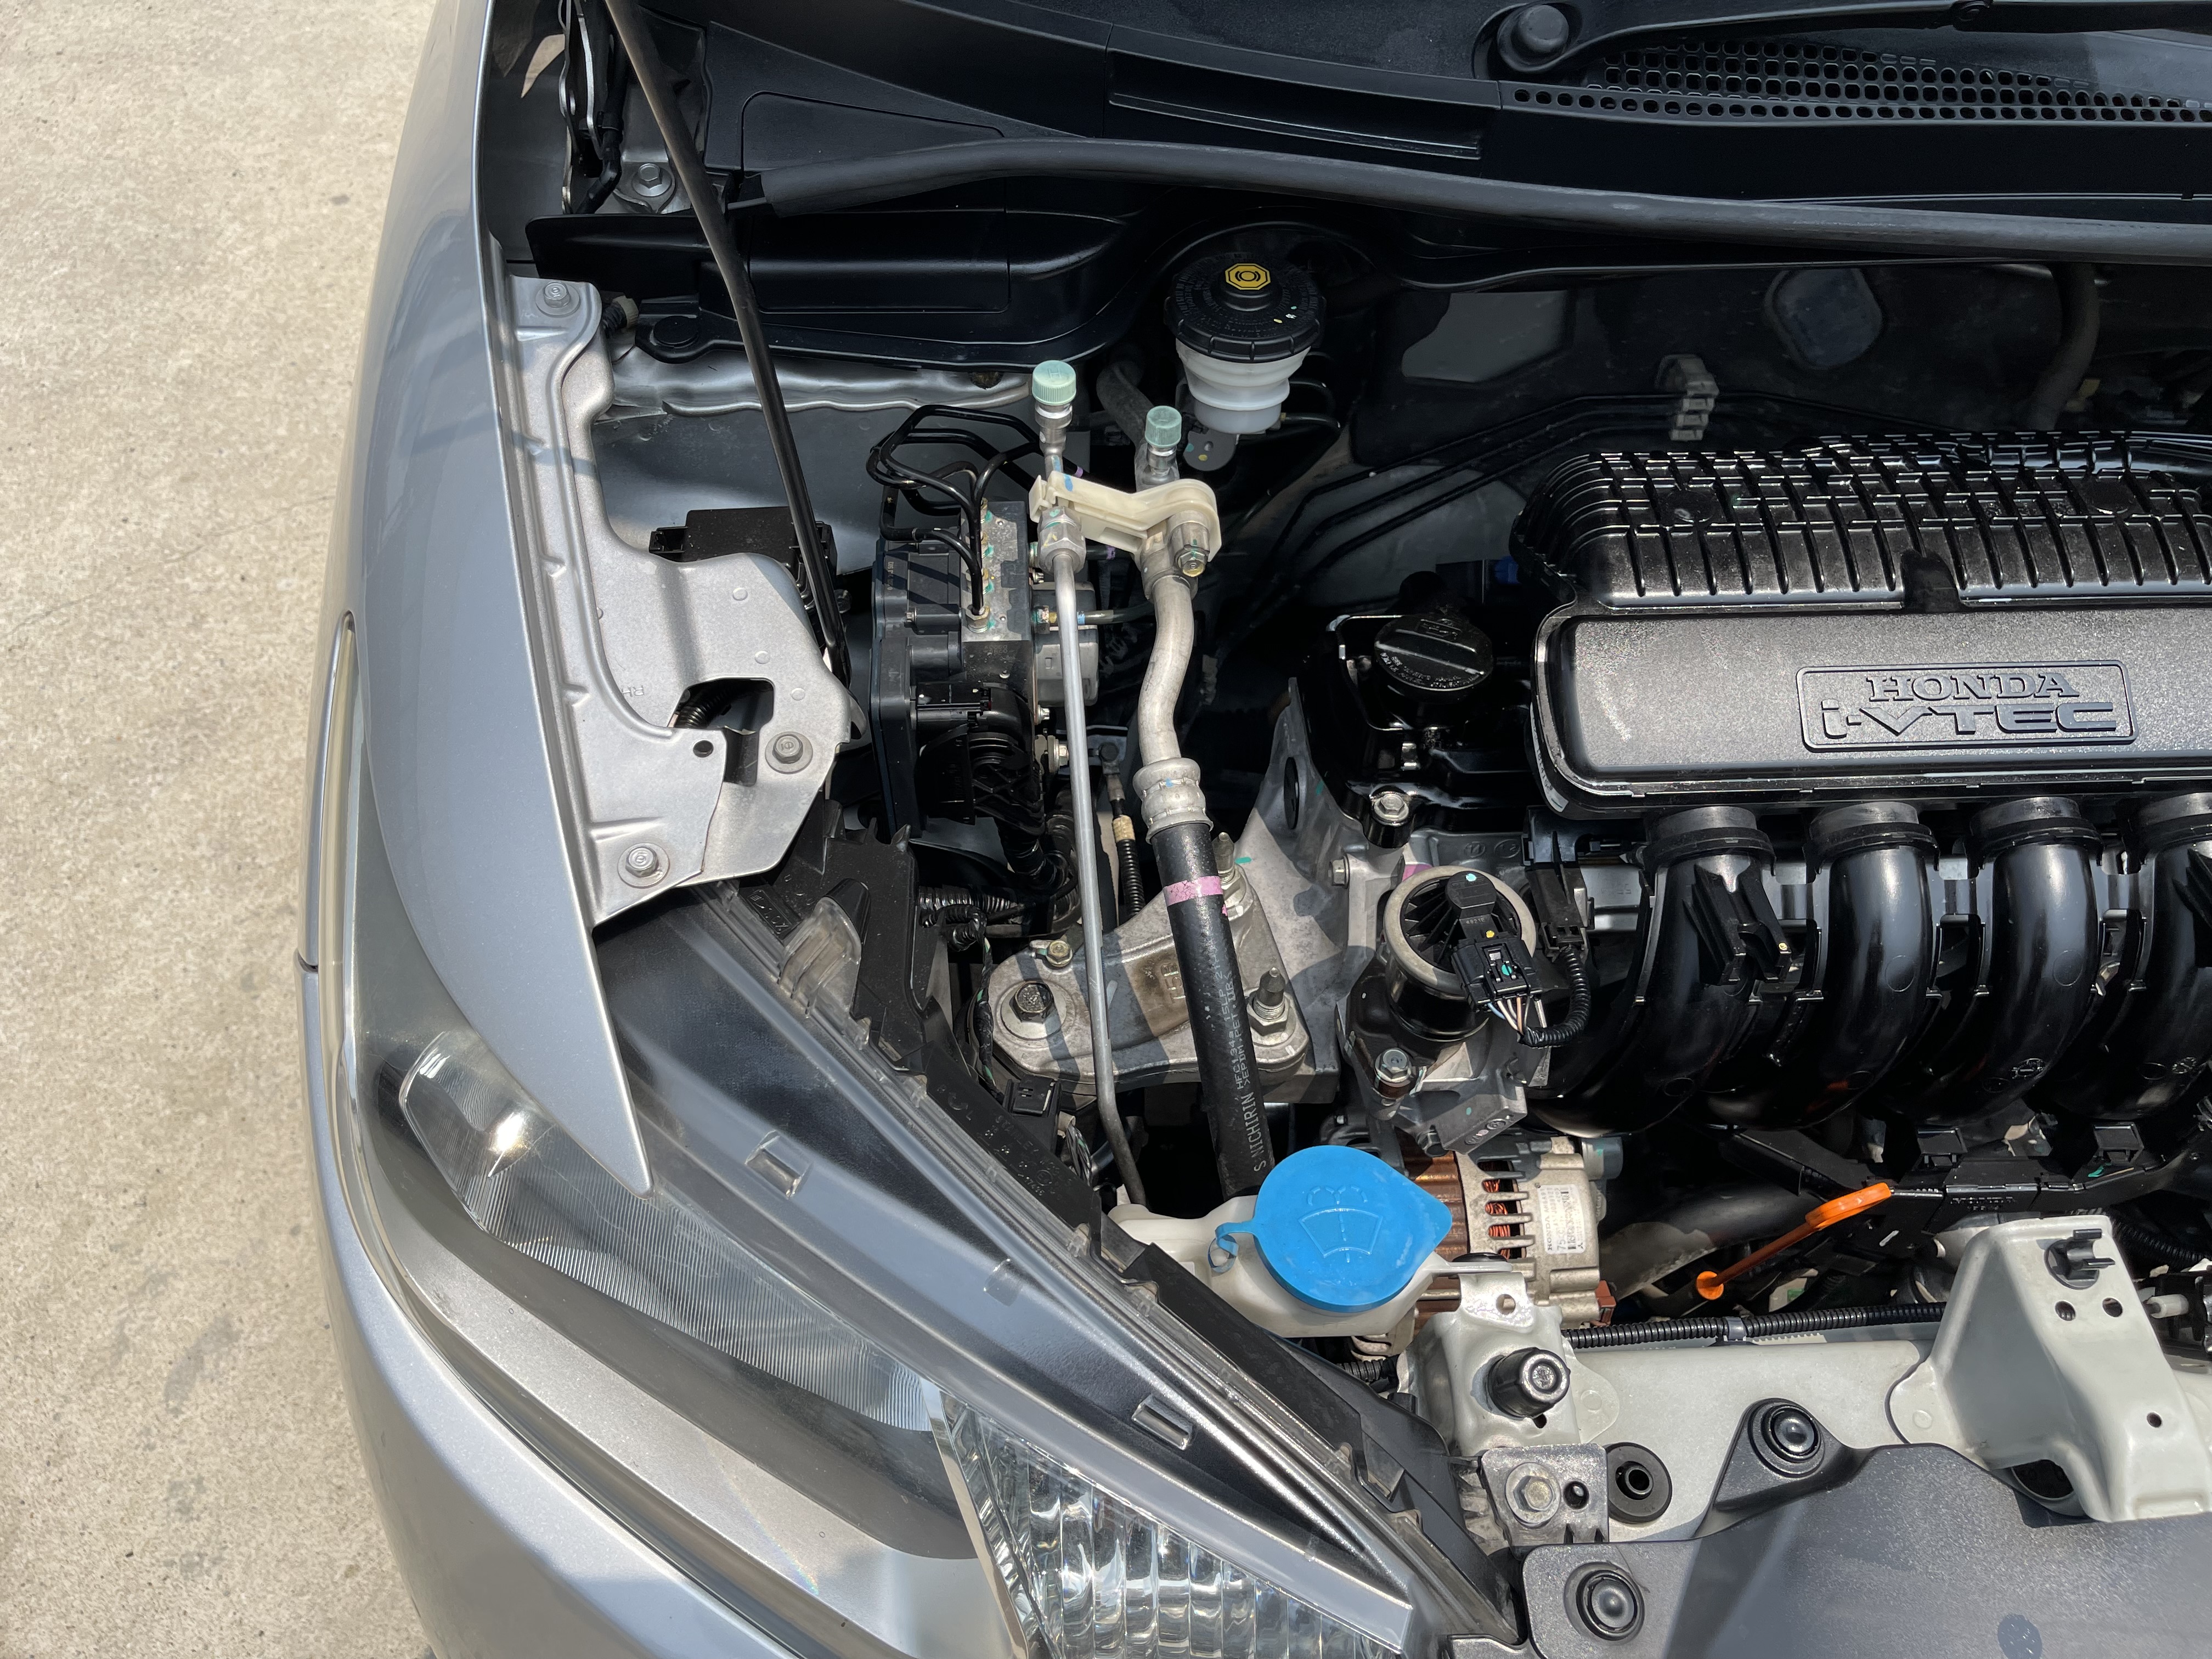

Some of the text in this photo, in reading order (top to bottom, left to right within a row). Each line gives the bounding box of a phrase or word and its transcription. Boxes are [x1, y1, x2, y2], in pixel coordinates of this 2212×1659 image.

[1047, 368, 1062, 379] H
[1865, 672, 2079, 703] HONDA
[1820, 698, 2118, 739] i-VTEC
[995, 1114, 1040, 1152] STANLEY
[1240, 1091, 1265, 1158] NICHIRIN
